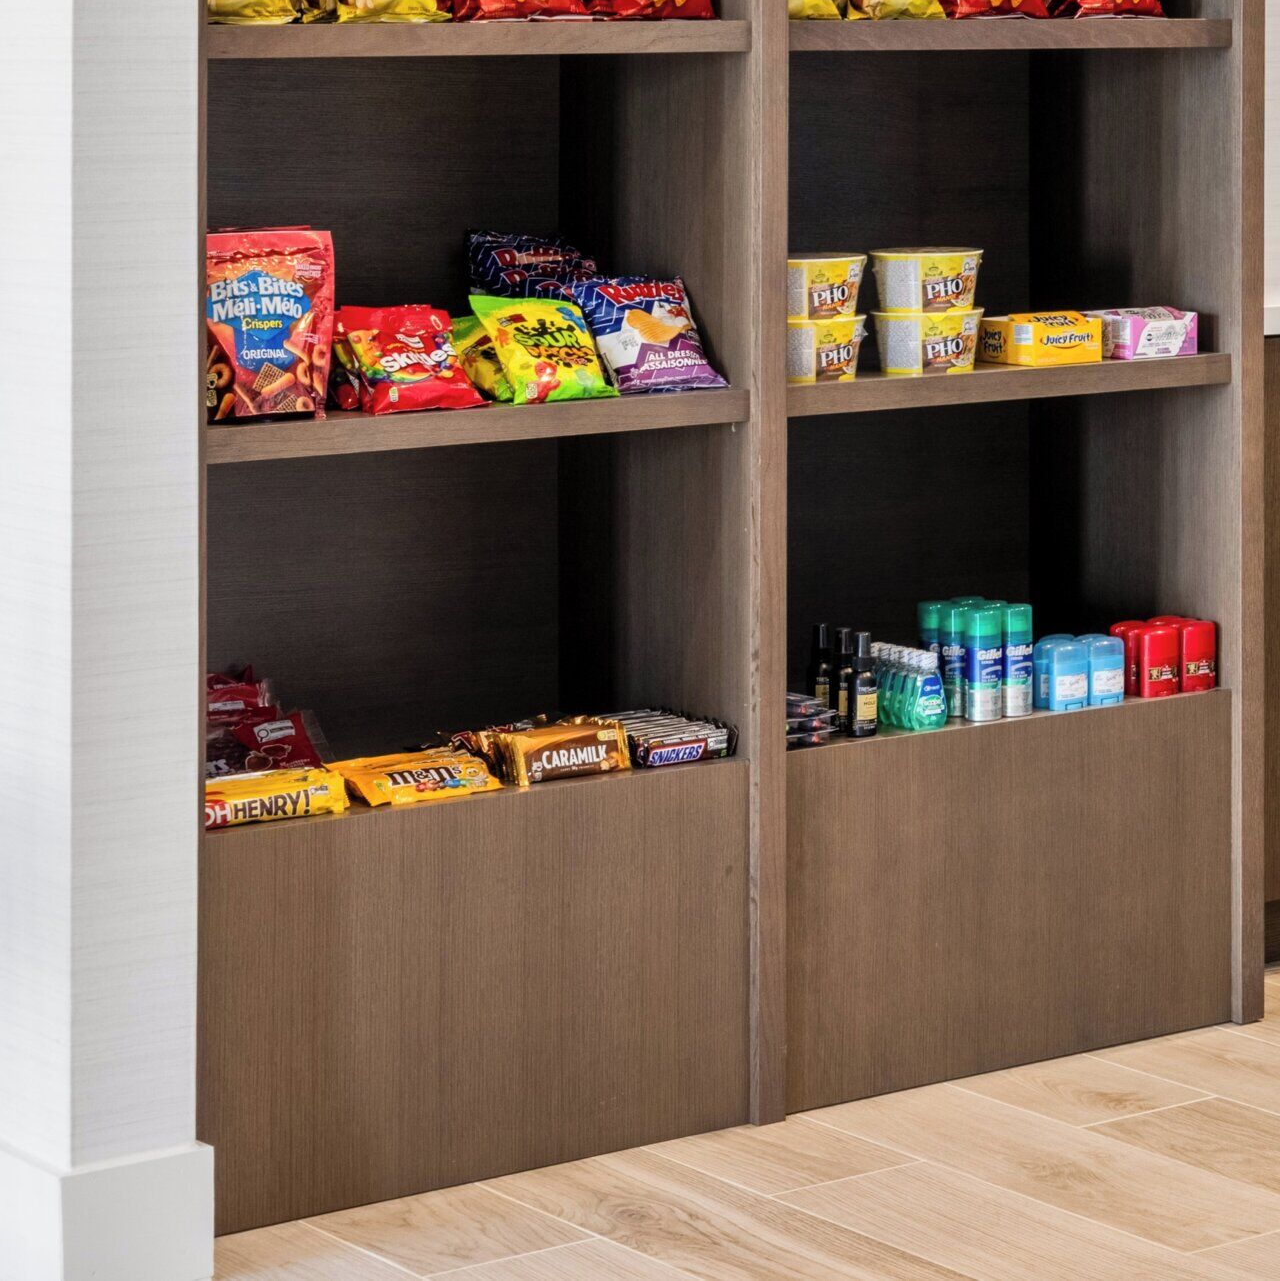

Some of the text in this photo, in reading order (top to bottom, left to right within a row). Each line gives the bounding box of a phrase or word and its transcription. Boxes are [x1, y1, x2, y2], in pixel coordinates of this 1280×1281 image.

[210, 280, 250, 303] Bits
[258, 276, 304, 298] Bites
[243, 318, 283, 330] Crispers
[514, 329, 580, 349] SOUR
[983, 328, 1002, 341] Juicy
[1044, 332, 1091, 345] Juicy Fruit
[984, 341, 1003, 353] Fruit
[243, 348, 288, 360] ORIGINAL
[648, 352, 665, 361] ALL
[542, 744, 607, 769] CARAMILK
[650, 744, 702, 765] SNICKERS
[233, 789, 310, 820] HENRY!
